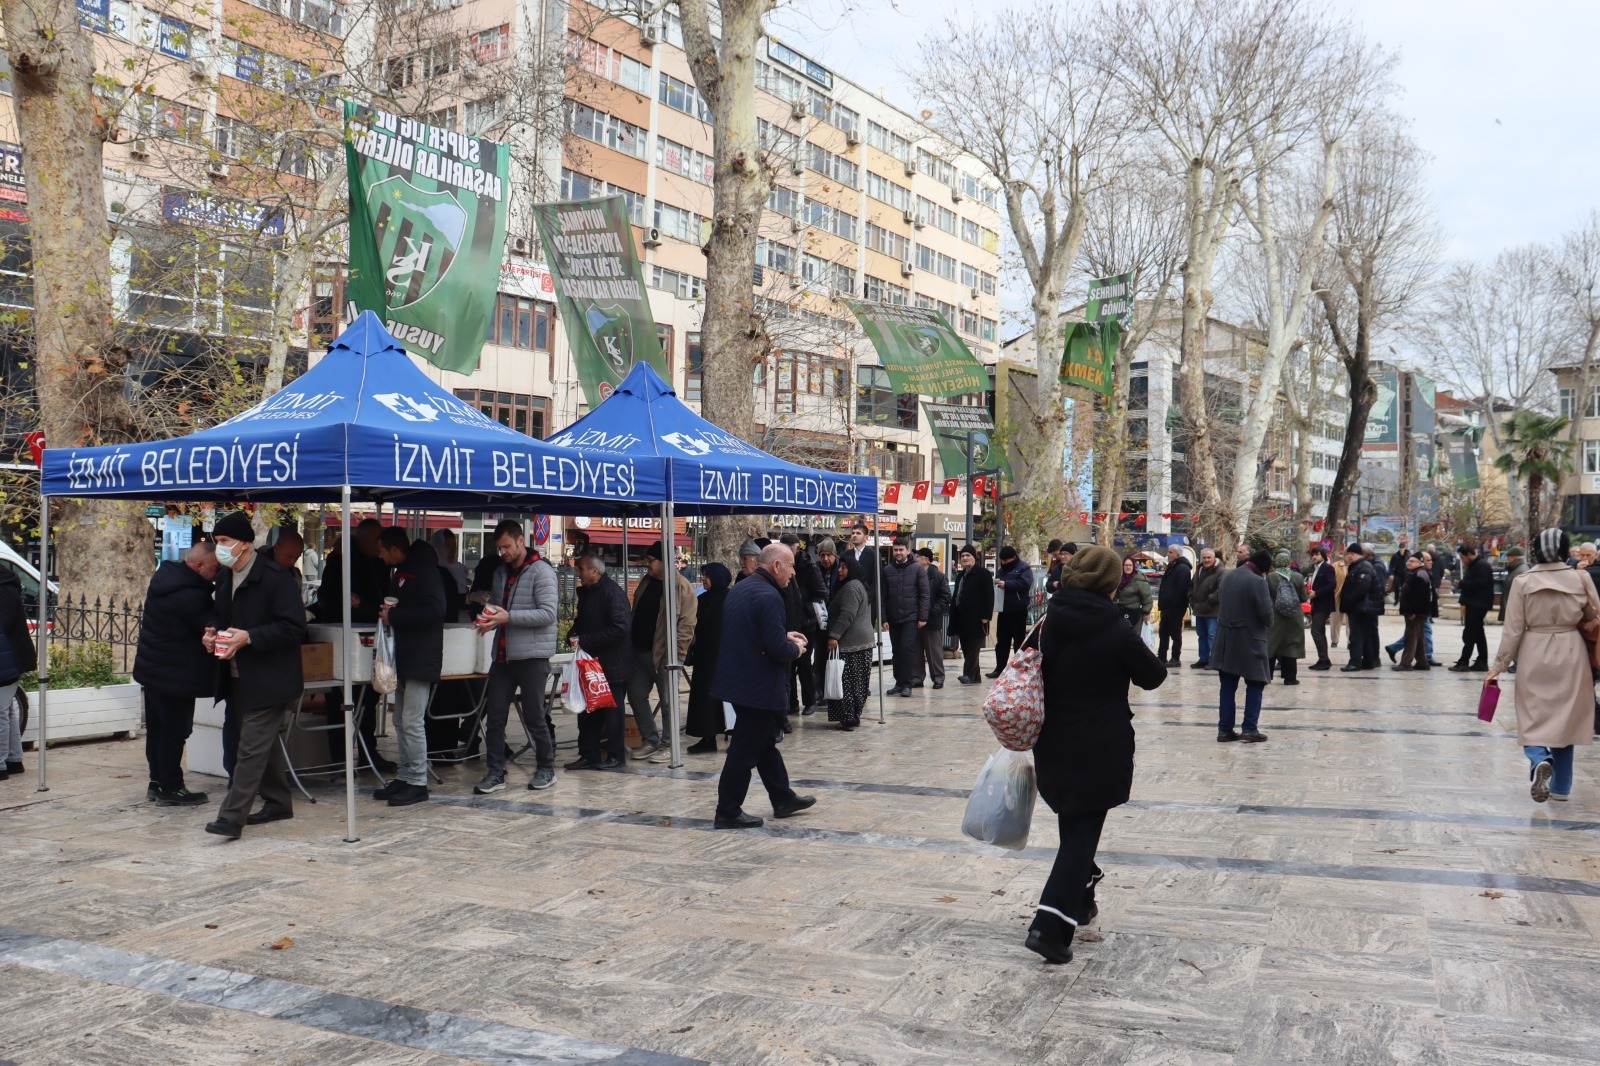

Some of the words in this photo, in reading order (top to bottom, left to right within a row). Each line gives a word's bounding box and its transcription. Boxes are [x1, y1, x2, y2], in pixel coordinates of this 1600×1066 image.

[557, 207, 607, 235] ŞAMPİYON
[264, 390, 345, 411] İZMİT
[572, 427, 642, 450] İZMİT
[66, 447, 131, 489] İZMİT
[141, 432, 301, 487] BELEDİYESİ
[393, 433, 475, 486] İZMİT
[492, 451, 636, 497] BELEDİYESİ
[699, 463, 752, 501] İZMİT
[761, 474, 857, 510] BELEDİYESİ
[771, 514, 806, 528] CADDE
